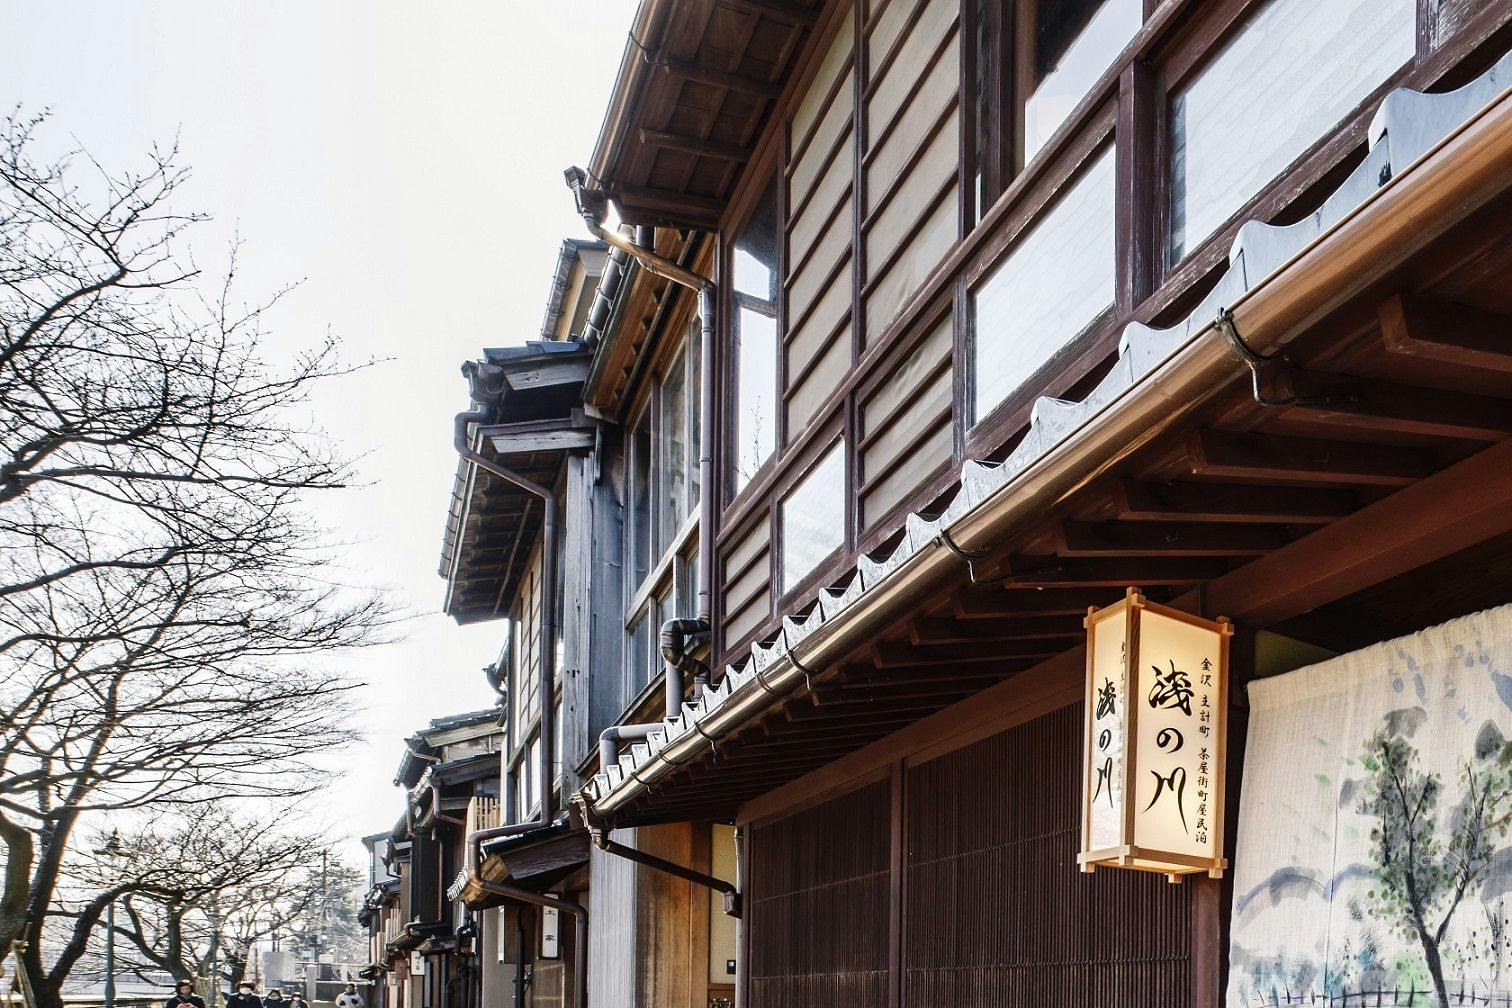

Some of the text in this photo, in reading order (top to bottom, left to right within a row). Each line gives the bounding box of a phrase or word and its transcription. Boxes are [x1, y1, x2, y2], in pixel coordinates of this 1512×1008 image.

[1200, 657, 1213, 688] 金沢
[1198, 693, 1211, 739] 主計町
